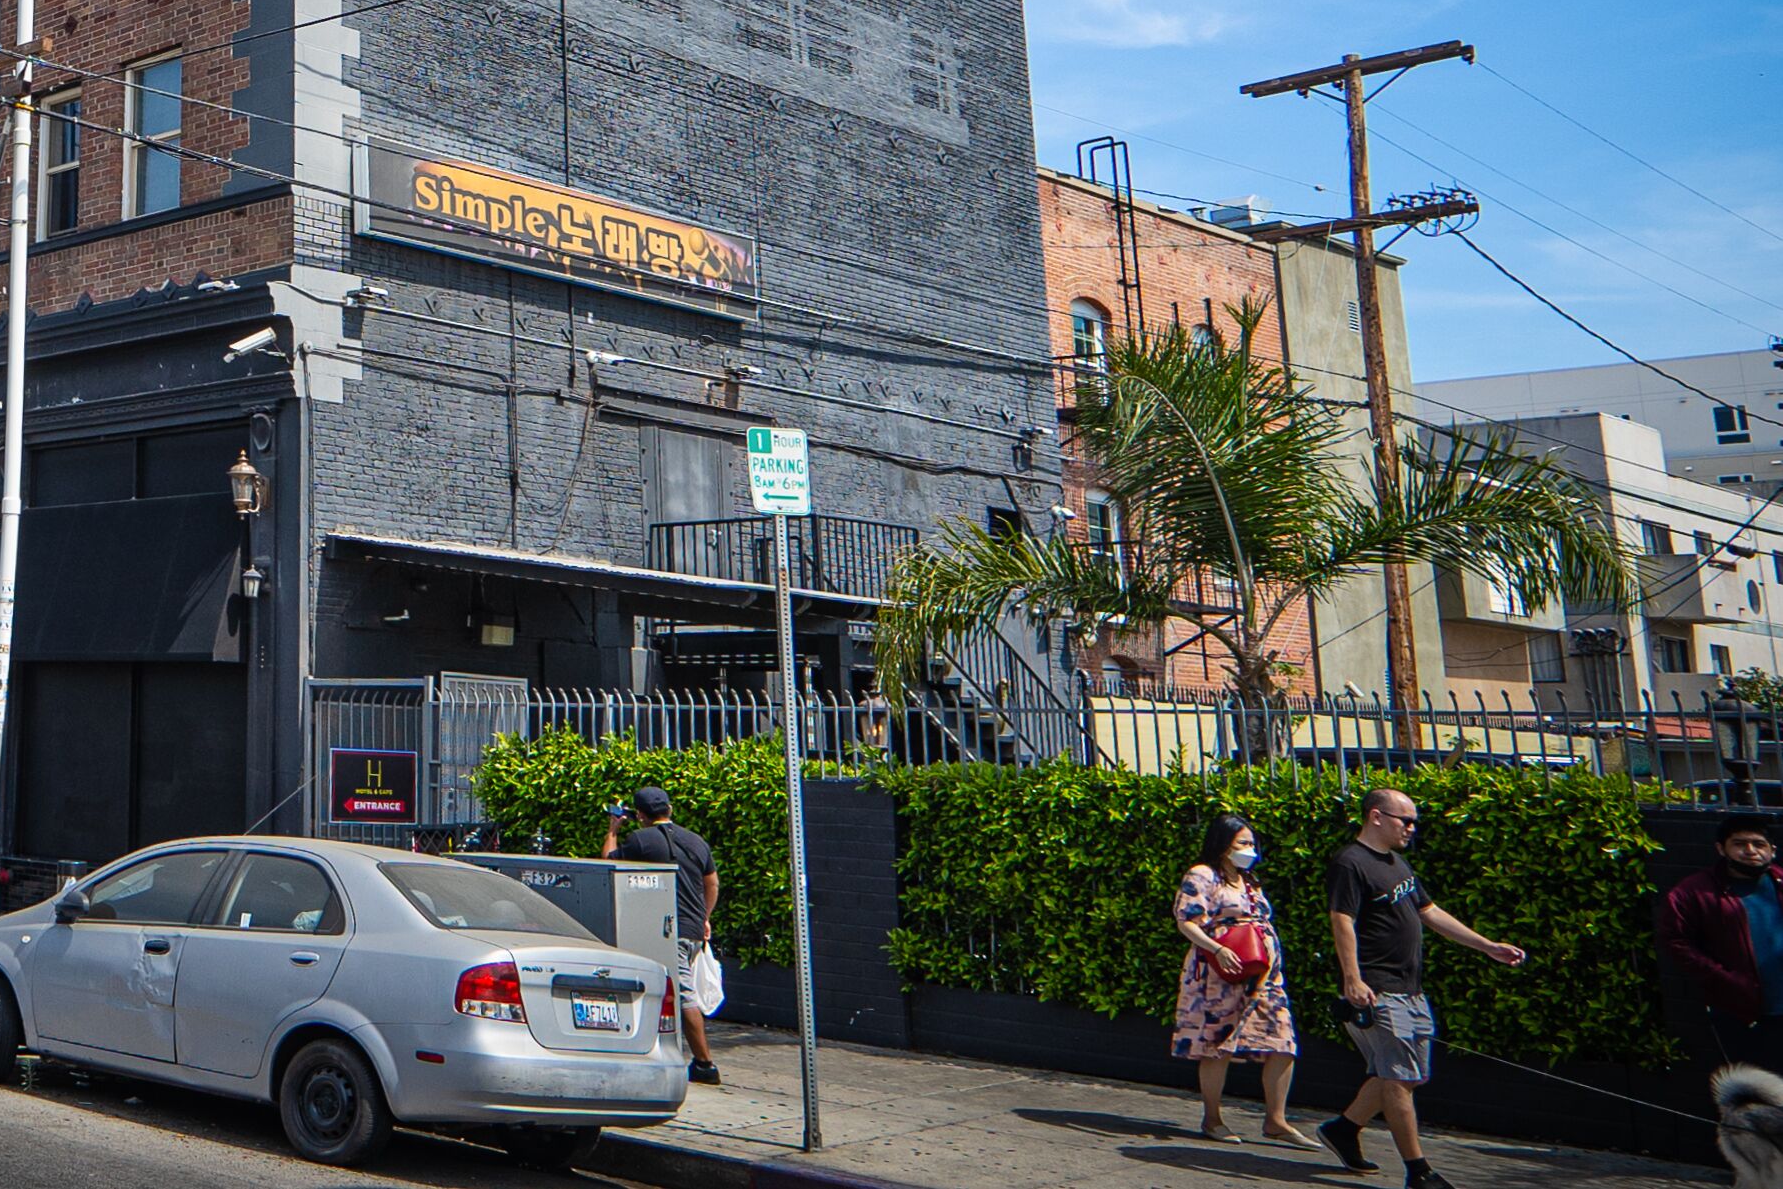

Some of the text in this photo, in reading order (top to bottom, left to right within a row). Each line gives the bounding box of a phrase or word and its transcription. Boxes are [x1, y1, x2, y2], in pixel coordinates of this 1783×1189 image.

[415, 175, 549, 235] Simple
[559, 205, 683, 278] 노래방
[757, 432, 802, 450] 1 HOUR
[752, 457, 804, 474] PARKING
[367, 759, 382, 788] H
[354, 801, 401, 811] ENTRANCE
